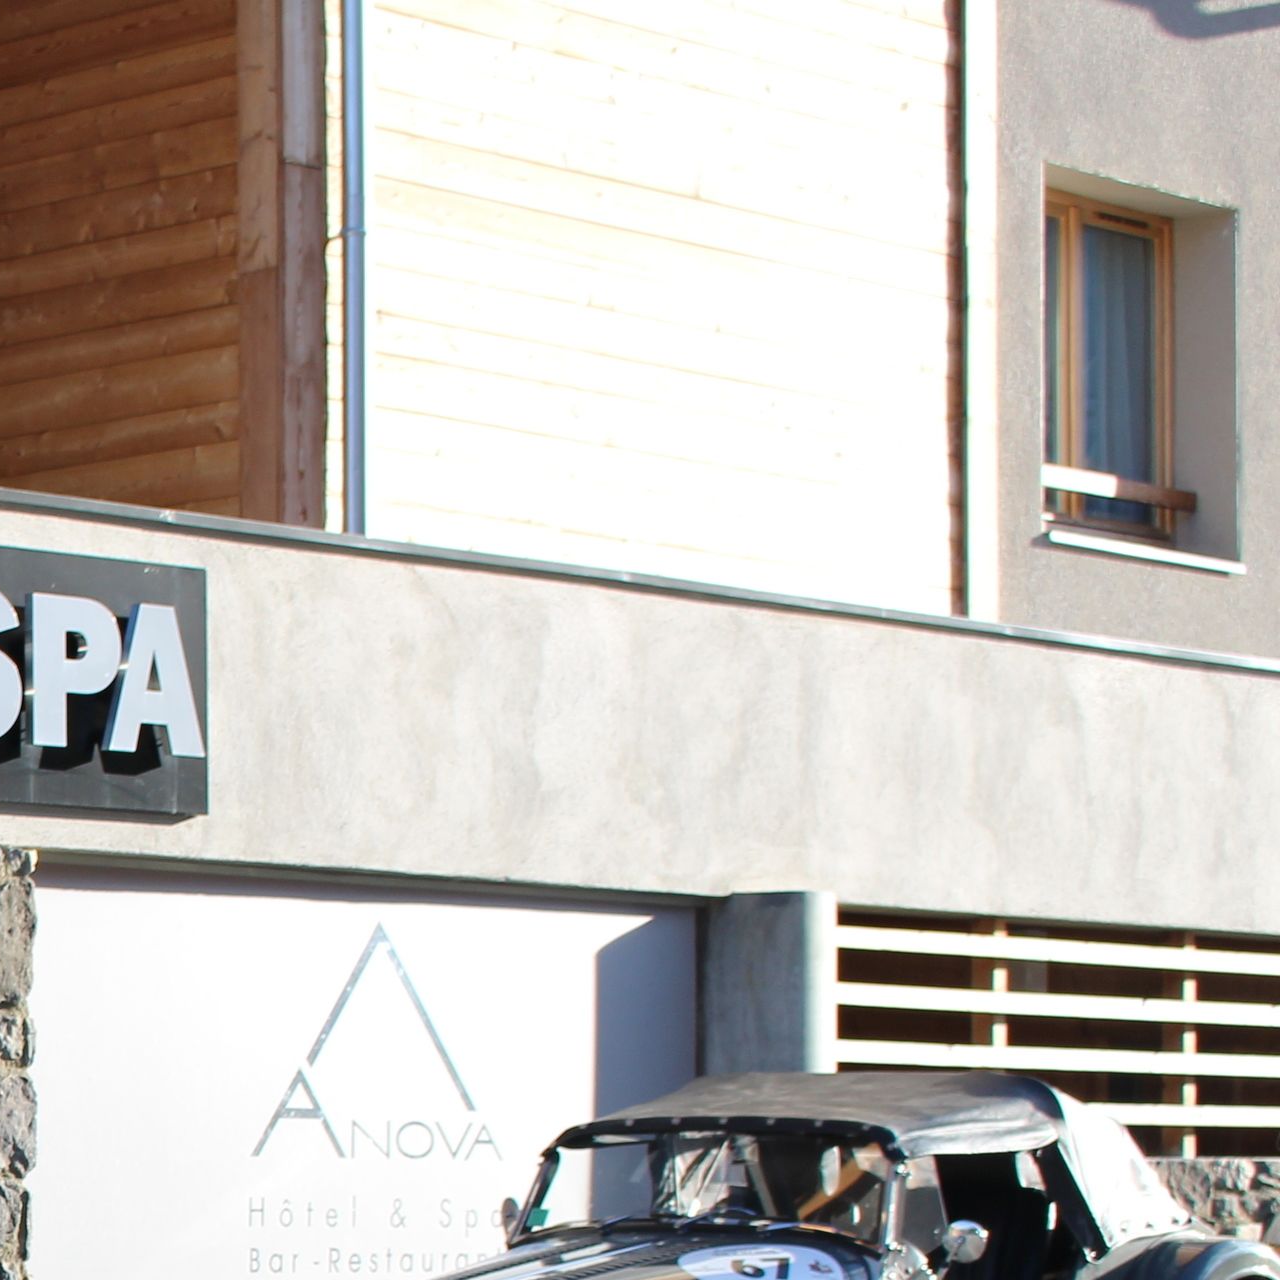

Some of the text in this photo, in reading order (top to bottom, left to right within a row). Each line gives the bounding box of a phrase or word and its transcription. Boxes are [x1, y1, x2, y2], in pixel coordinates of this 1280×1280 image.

[250, 1067, 503, 1161] ANOVA
[247, 1194, 357, 1228] Hôtel
[389, 1198, 407, 1228] &
